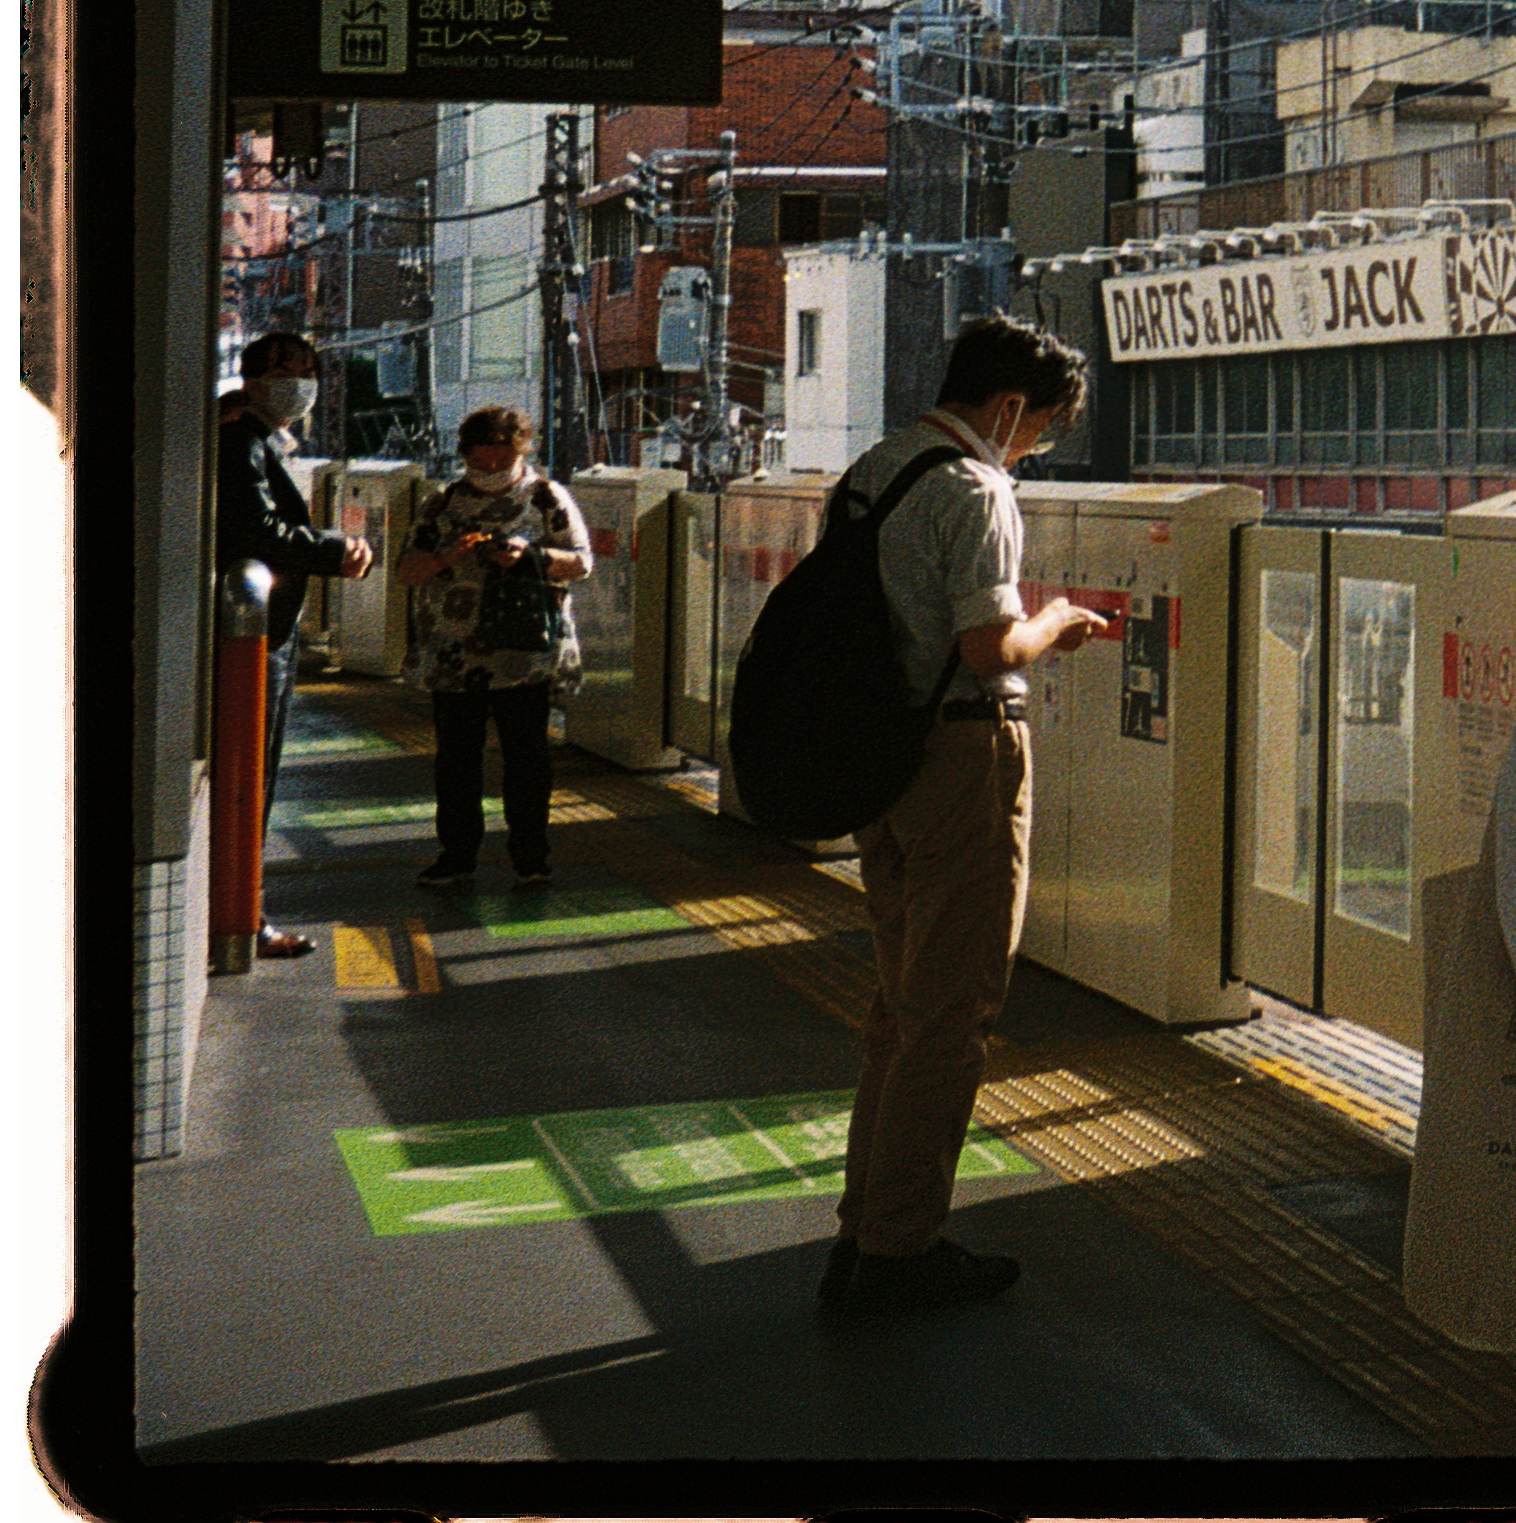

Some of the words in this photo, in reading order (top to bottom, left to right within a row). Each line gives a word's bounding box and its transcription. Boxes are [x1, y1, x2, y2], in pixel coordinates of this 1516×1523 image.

[418, 27, 569, 51] エレベーター
[416, 52, 478, 69] Elevator
[484, 54, 498, 69] to
[503, 53, 547, 69] Ticket
[552, 54, 589, 70] Gate
[594, 55, 635, 71] Level
[1112, 280, 1198, 351] DARTS
[1202, 298, 1220, 345] &
[1220, 273, 1283, 346] BAR
[1320, 256, 1425, 332] JACK
